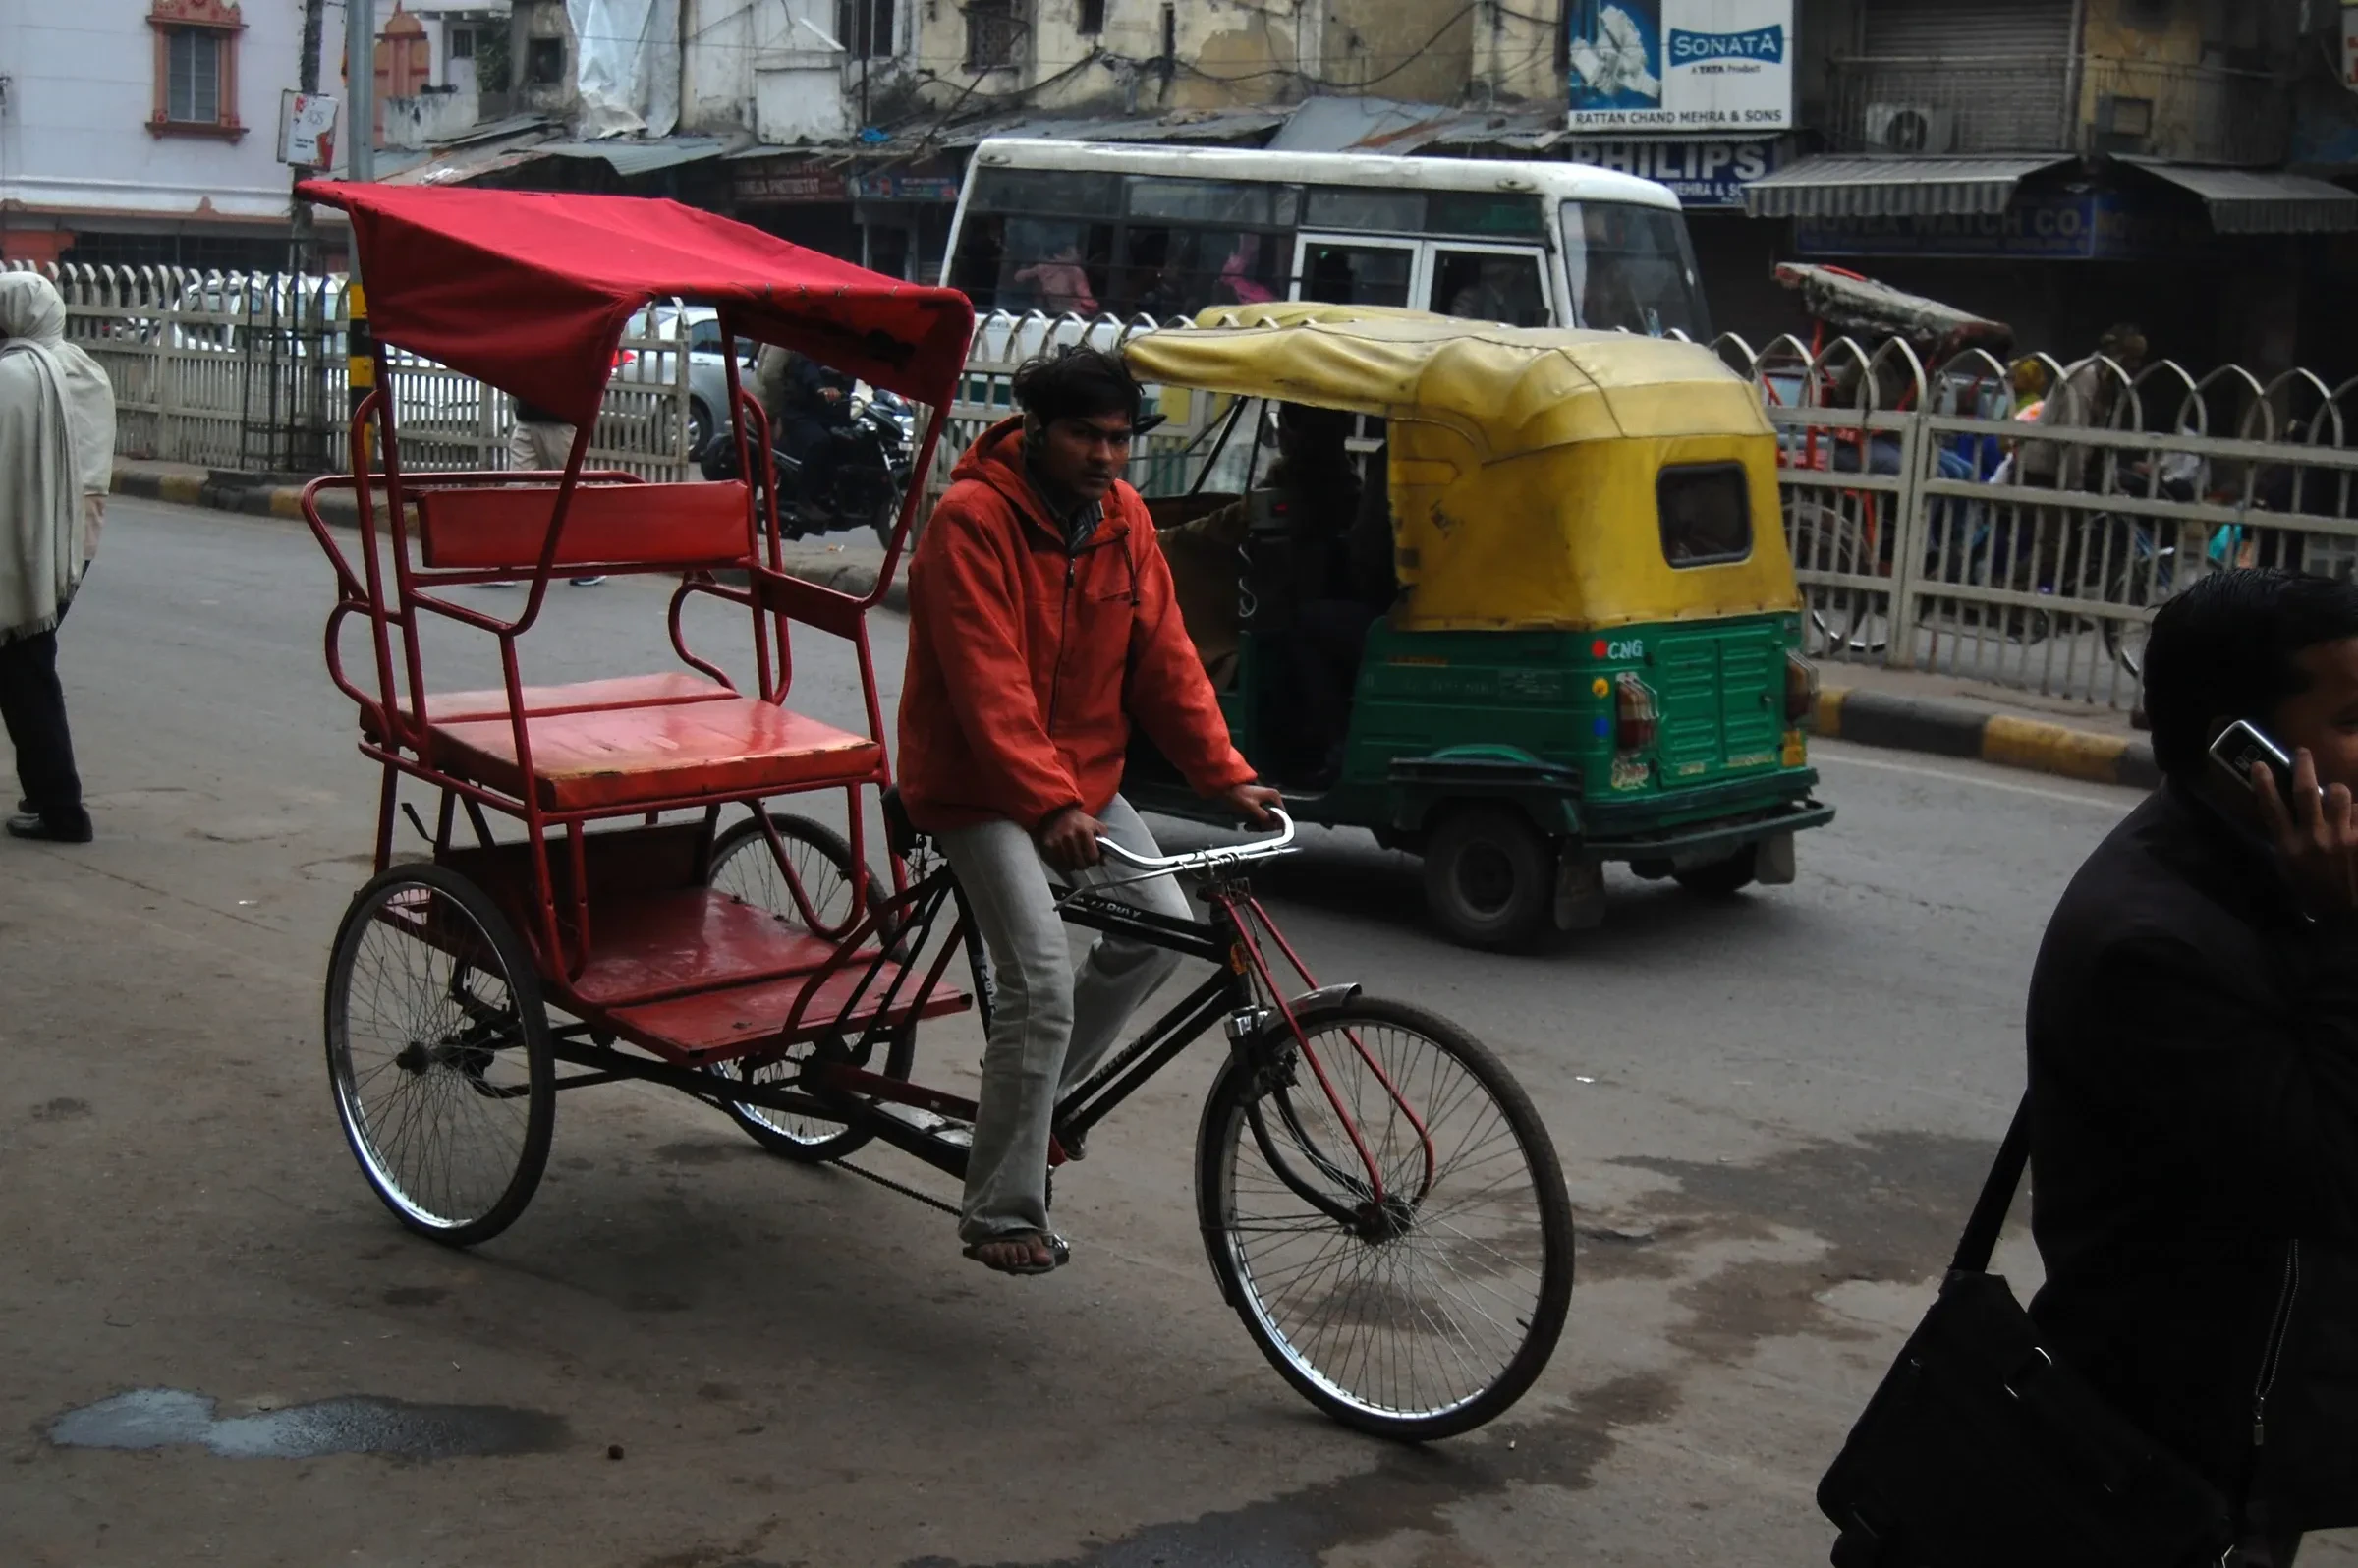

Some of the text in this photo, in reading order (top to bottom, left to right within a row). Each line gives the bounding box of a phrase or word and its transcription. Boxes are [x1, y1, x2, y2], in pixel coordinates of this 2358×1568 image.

[1673, 32, 1777, 57] SONATA
[1700, 65, 1724, 74] TATA
[1576, 109, 1782, 124] RATTAN CHAND MEHRA & SONS
[1572, 141, 1766, 180] PHILIPS
[1912, 209, 2024, 237] WATCH
[1606, 639, 1644, 660] CNG
